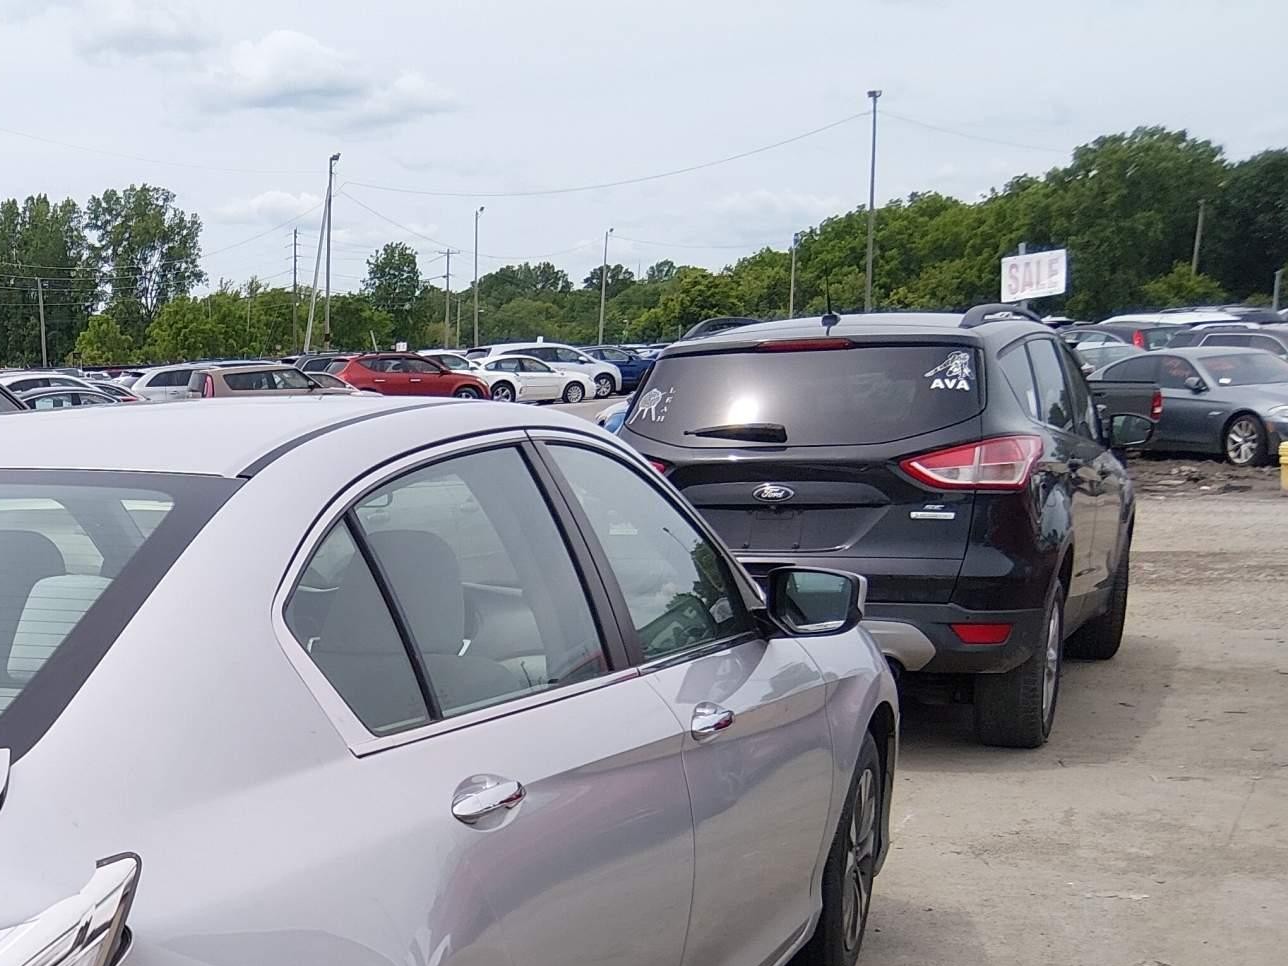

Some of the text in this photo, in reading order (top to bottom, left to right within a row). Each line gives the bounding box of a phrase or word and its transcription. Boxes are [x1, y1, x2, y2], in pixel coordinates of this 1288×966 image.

[1007, 257, 1059, 295] SALE
[929, 378, 970, 391] AVA
[760, 488, 785, 498] Ford
